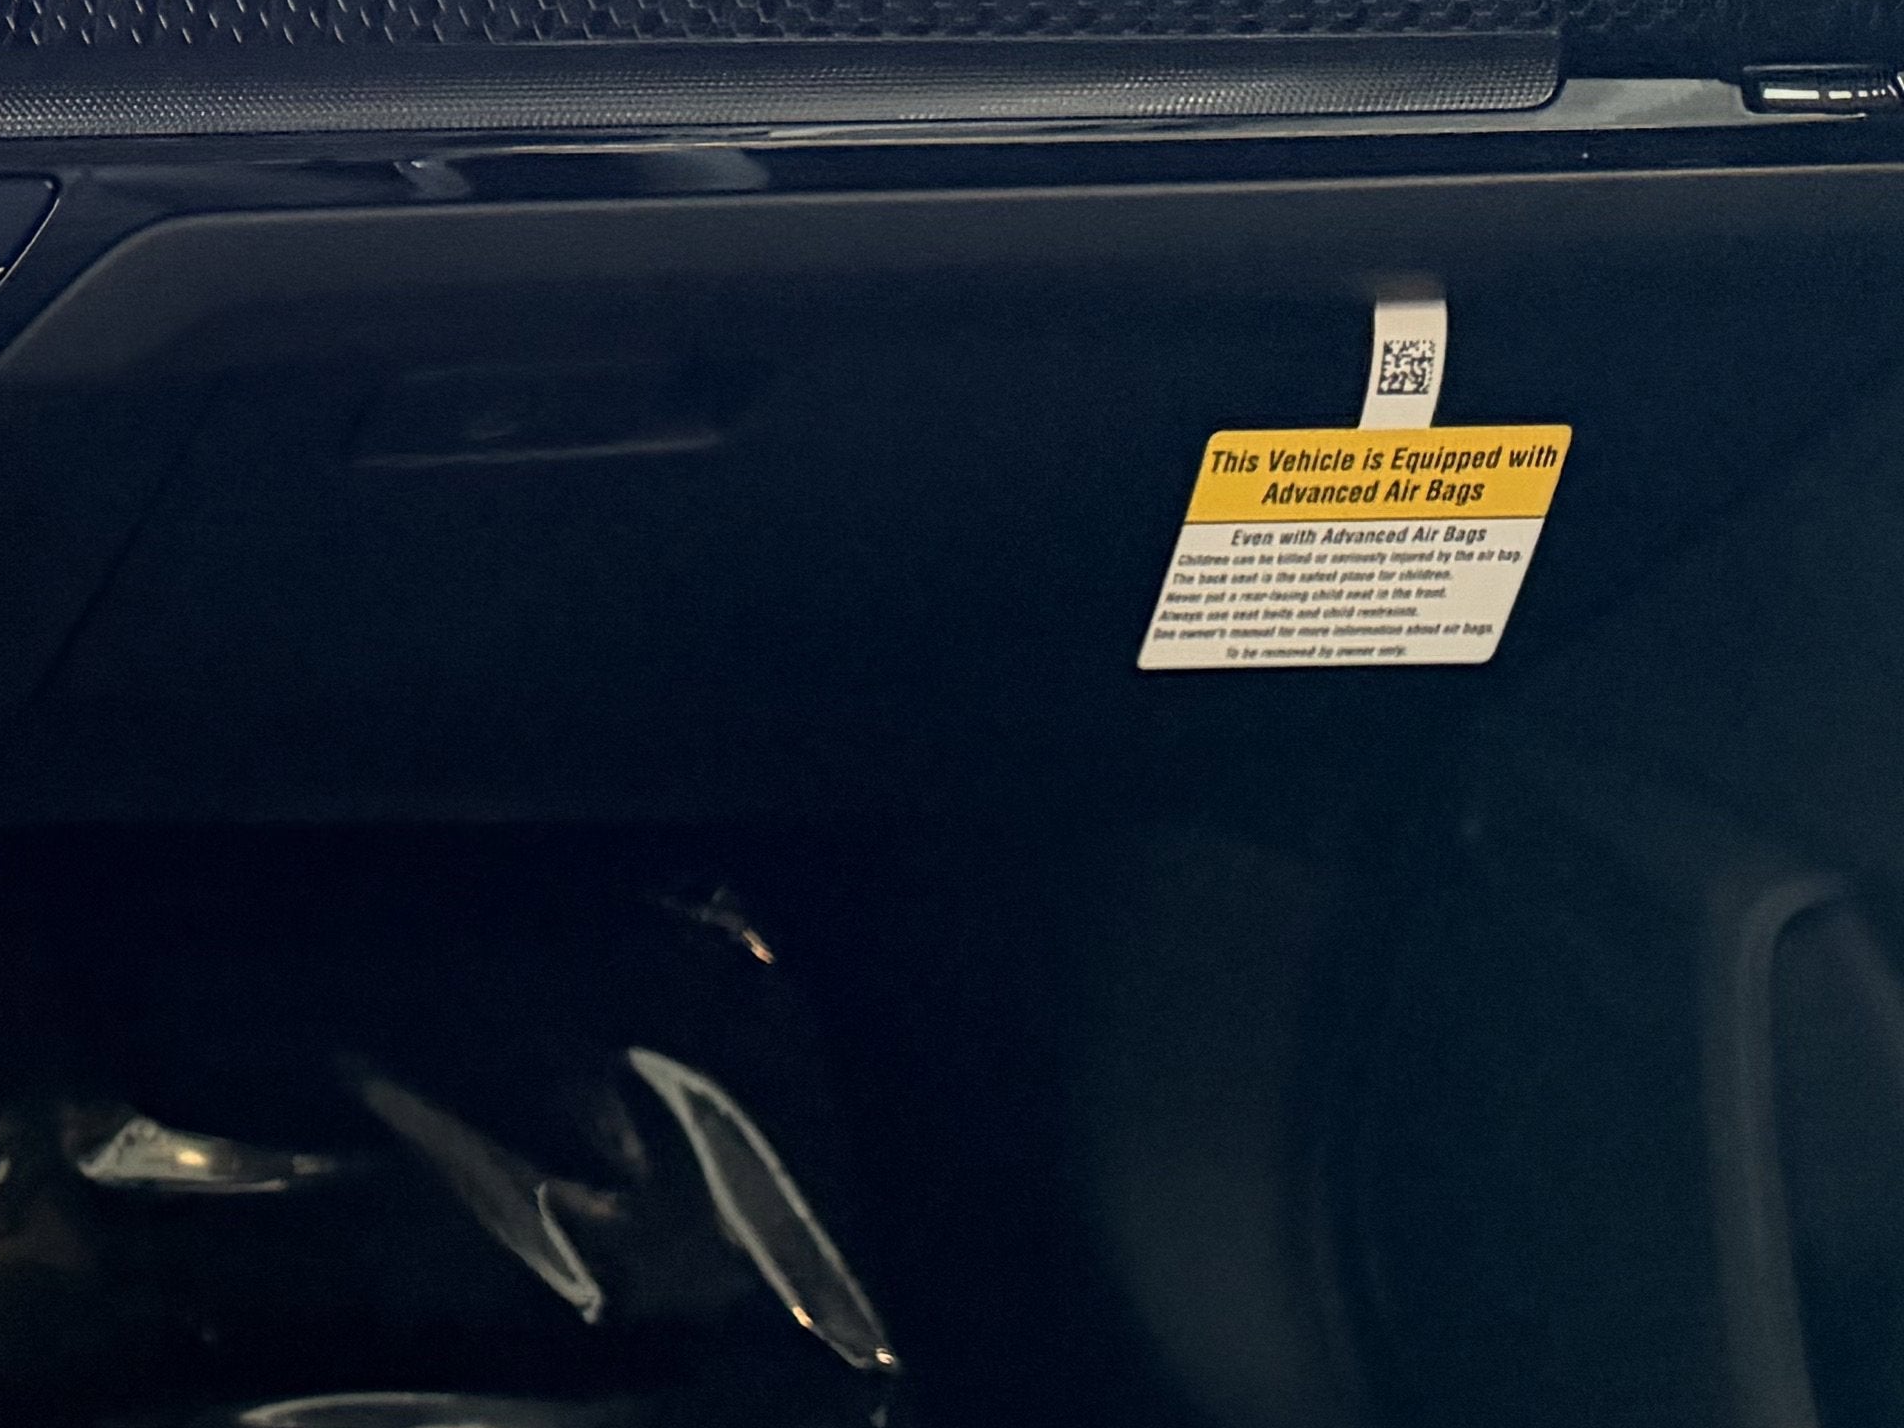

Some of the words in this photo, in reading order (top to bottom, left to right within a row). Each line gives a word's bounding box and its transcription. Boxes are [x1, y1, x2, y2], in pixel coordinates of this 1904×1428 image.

[1211, 450, 1259, 473] This
[1268, 448, 1356, 472] Vehicle
[1362, 448, 1384, 471] is
[1391, 446, 1502, 474] Equipped
[1508, 445, 1558, 468] with
[1261, 481, 1380, 505] Advanced
[1384, 482, 1420, 501] Air
[1425, 479, 1485, 506] Bags
[1231, 529, 1274, 546] Even
[1279, 529, 1316, 544] with
[1321, 528, 1408, 544] Advanced
[1411, 528, 1437, 542] Air
[1443, 527, 1487, 545] Bags
[1437, 551, 1452, 563] by
[1454, 550, 1474, 561] the
[1391, 588, 1412, 599] the
